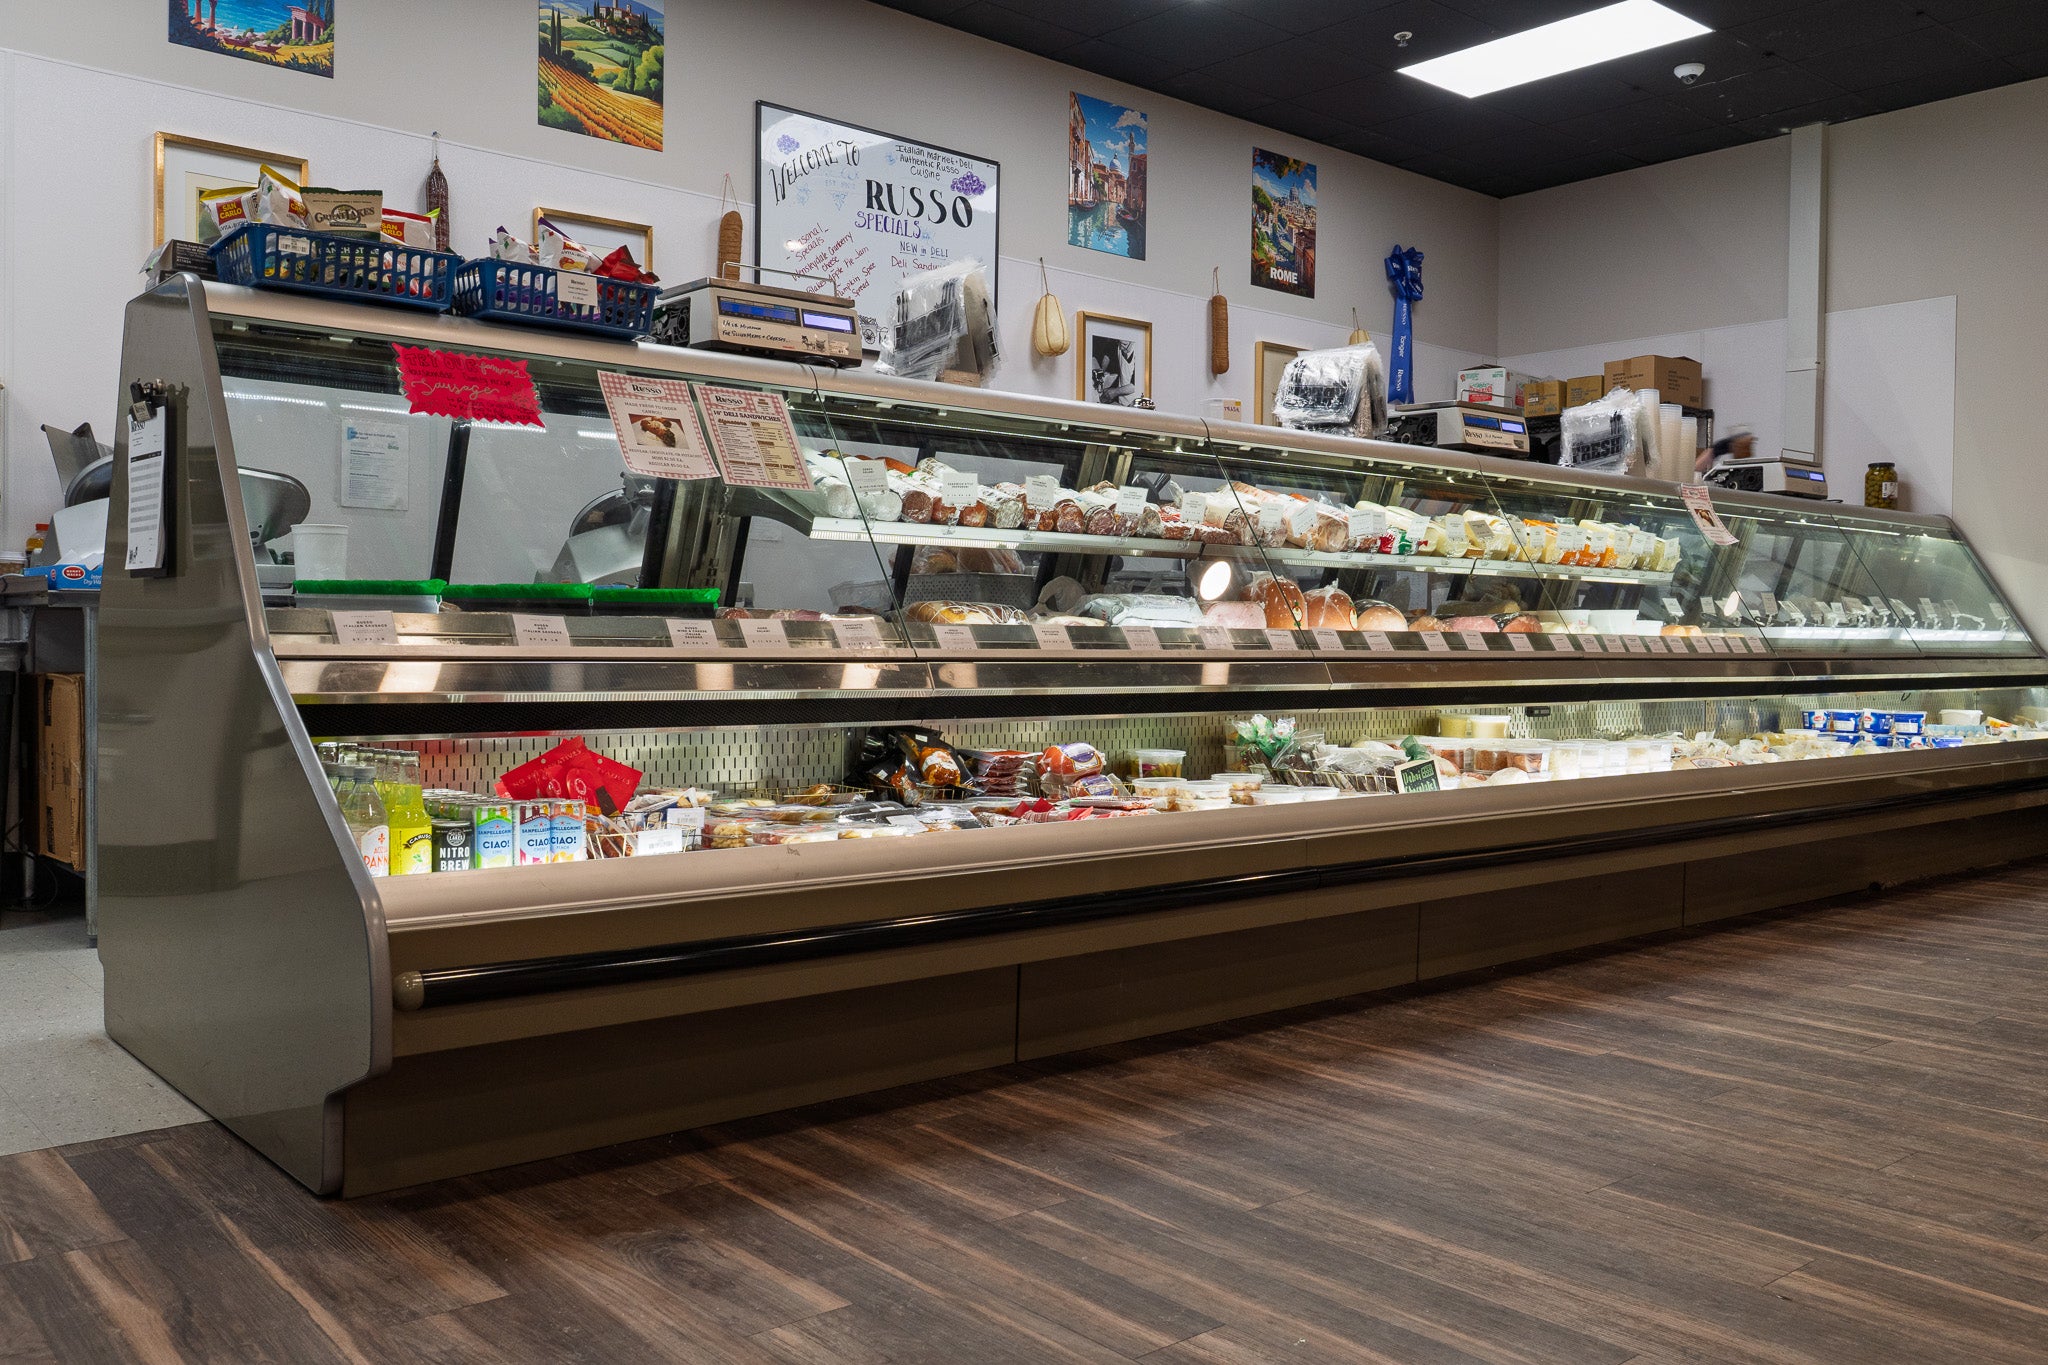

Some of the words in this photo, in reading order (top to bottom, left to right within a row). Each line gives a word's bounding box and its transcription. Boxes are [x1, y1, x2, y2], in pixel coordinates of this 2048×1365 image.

[900, 154, 935, 168] Authentic
[936, 162, 960, 175] Russo
[769, 142, 838, 206] WELCOME
[837, 140, 860, 166] TO
[910, 165, 941, 181] Cuisine
[222, 201, 237, 212] SAN
[865, 179, 973, 228] RUSSO
[219, 207, 243, 219] CARLO
[381, 222, 398, 231] SAN
[855, 211, 922, 239] SPECIALS
[900, 241, 918, 254] NEW
[930, 246, 949, 258] DELI
[891, 256, 908, 268] Deli
[1270, 266, 1298, 285] ROME
[411, 378, 500, 401] Sausage
[631, 384, 663, 395] RUSSO
[715, 395, 744, 406] RUSSO
[740, 413, 781, 422] SANDWICHES
[482, 840, 510, 849] CIAO!
[551, 836, 577, 845] CIAO!
[440, 846, 470, 859] NITRO
[440, 859, 470, 872] BREW
